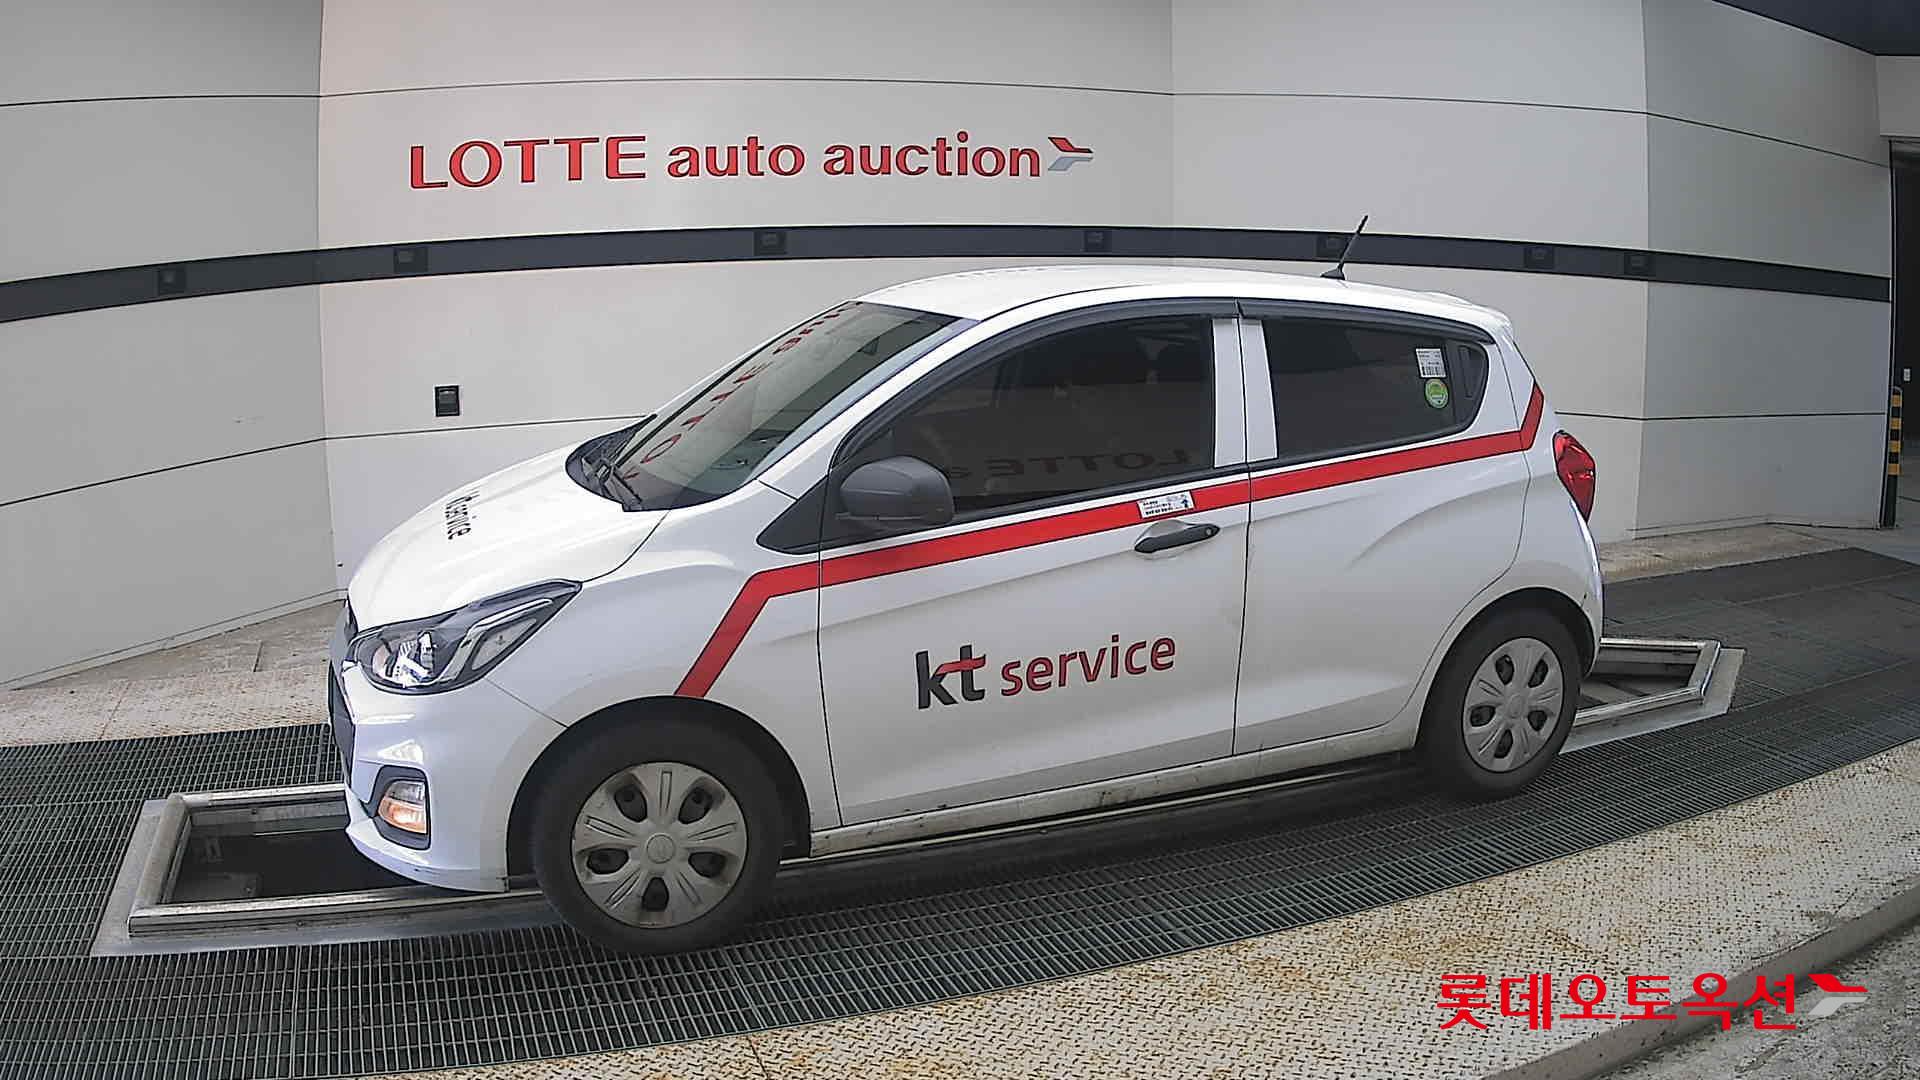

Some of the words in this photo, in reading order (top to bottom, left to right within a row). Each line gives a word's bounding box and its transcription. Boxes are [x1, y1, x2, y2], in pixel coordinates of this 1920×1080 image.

[410, 135, 646, 189] LOTTE
[667, 136, 806, 177] auto
[823, 131, 1041, 178] auction
[915, 645, 986, 709] kt
[1000, 634, 1176, 697] service
